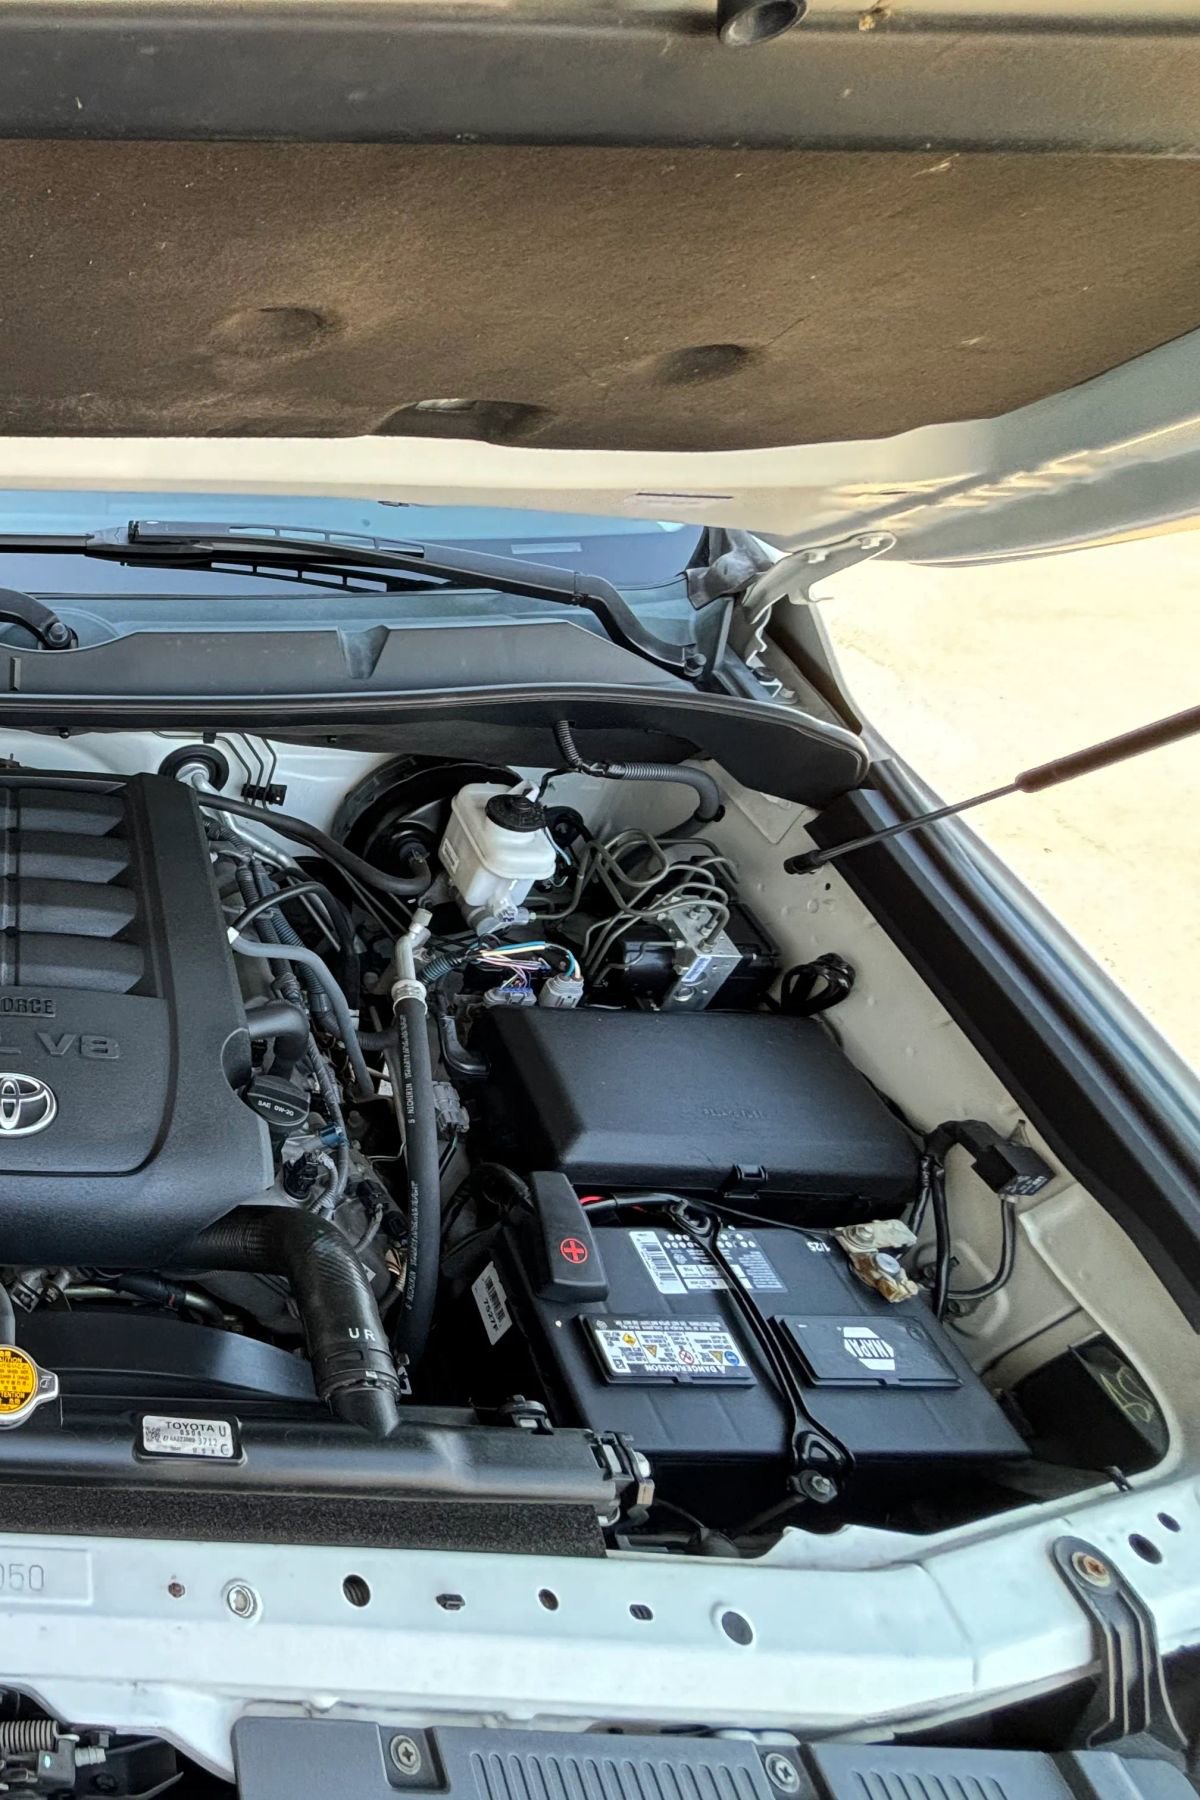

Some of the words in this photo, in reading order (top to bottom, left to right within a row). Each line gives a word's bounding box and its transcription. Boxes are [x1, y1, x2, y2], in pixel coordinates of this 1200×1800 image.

[35, 1031, 120, 1059] V8
[257, 1100, 271, 1109] SAE
[847, 1339, 891, 1358] NAPA
[165, 1421, 216, 1433] TOYOTA
[218, 1425, 227, 1437] U
